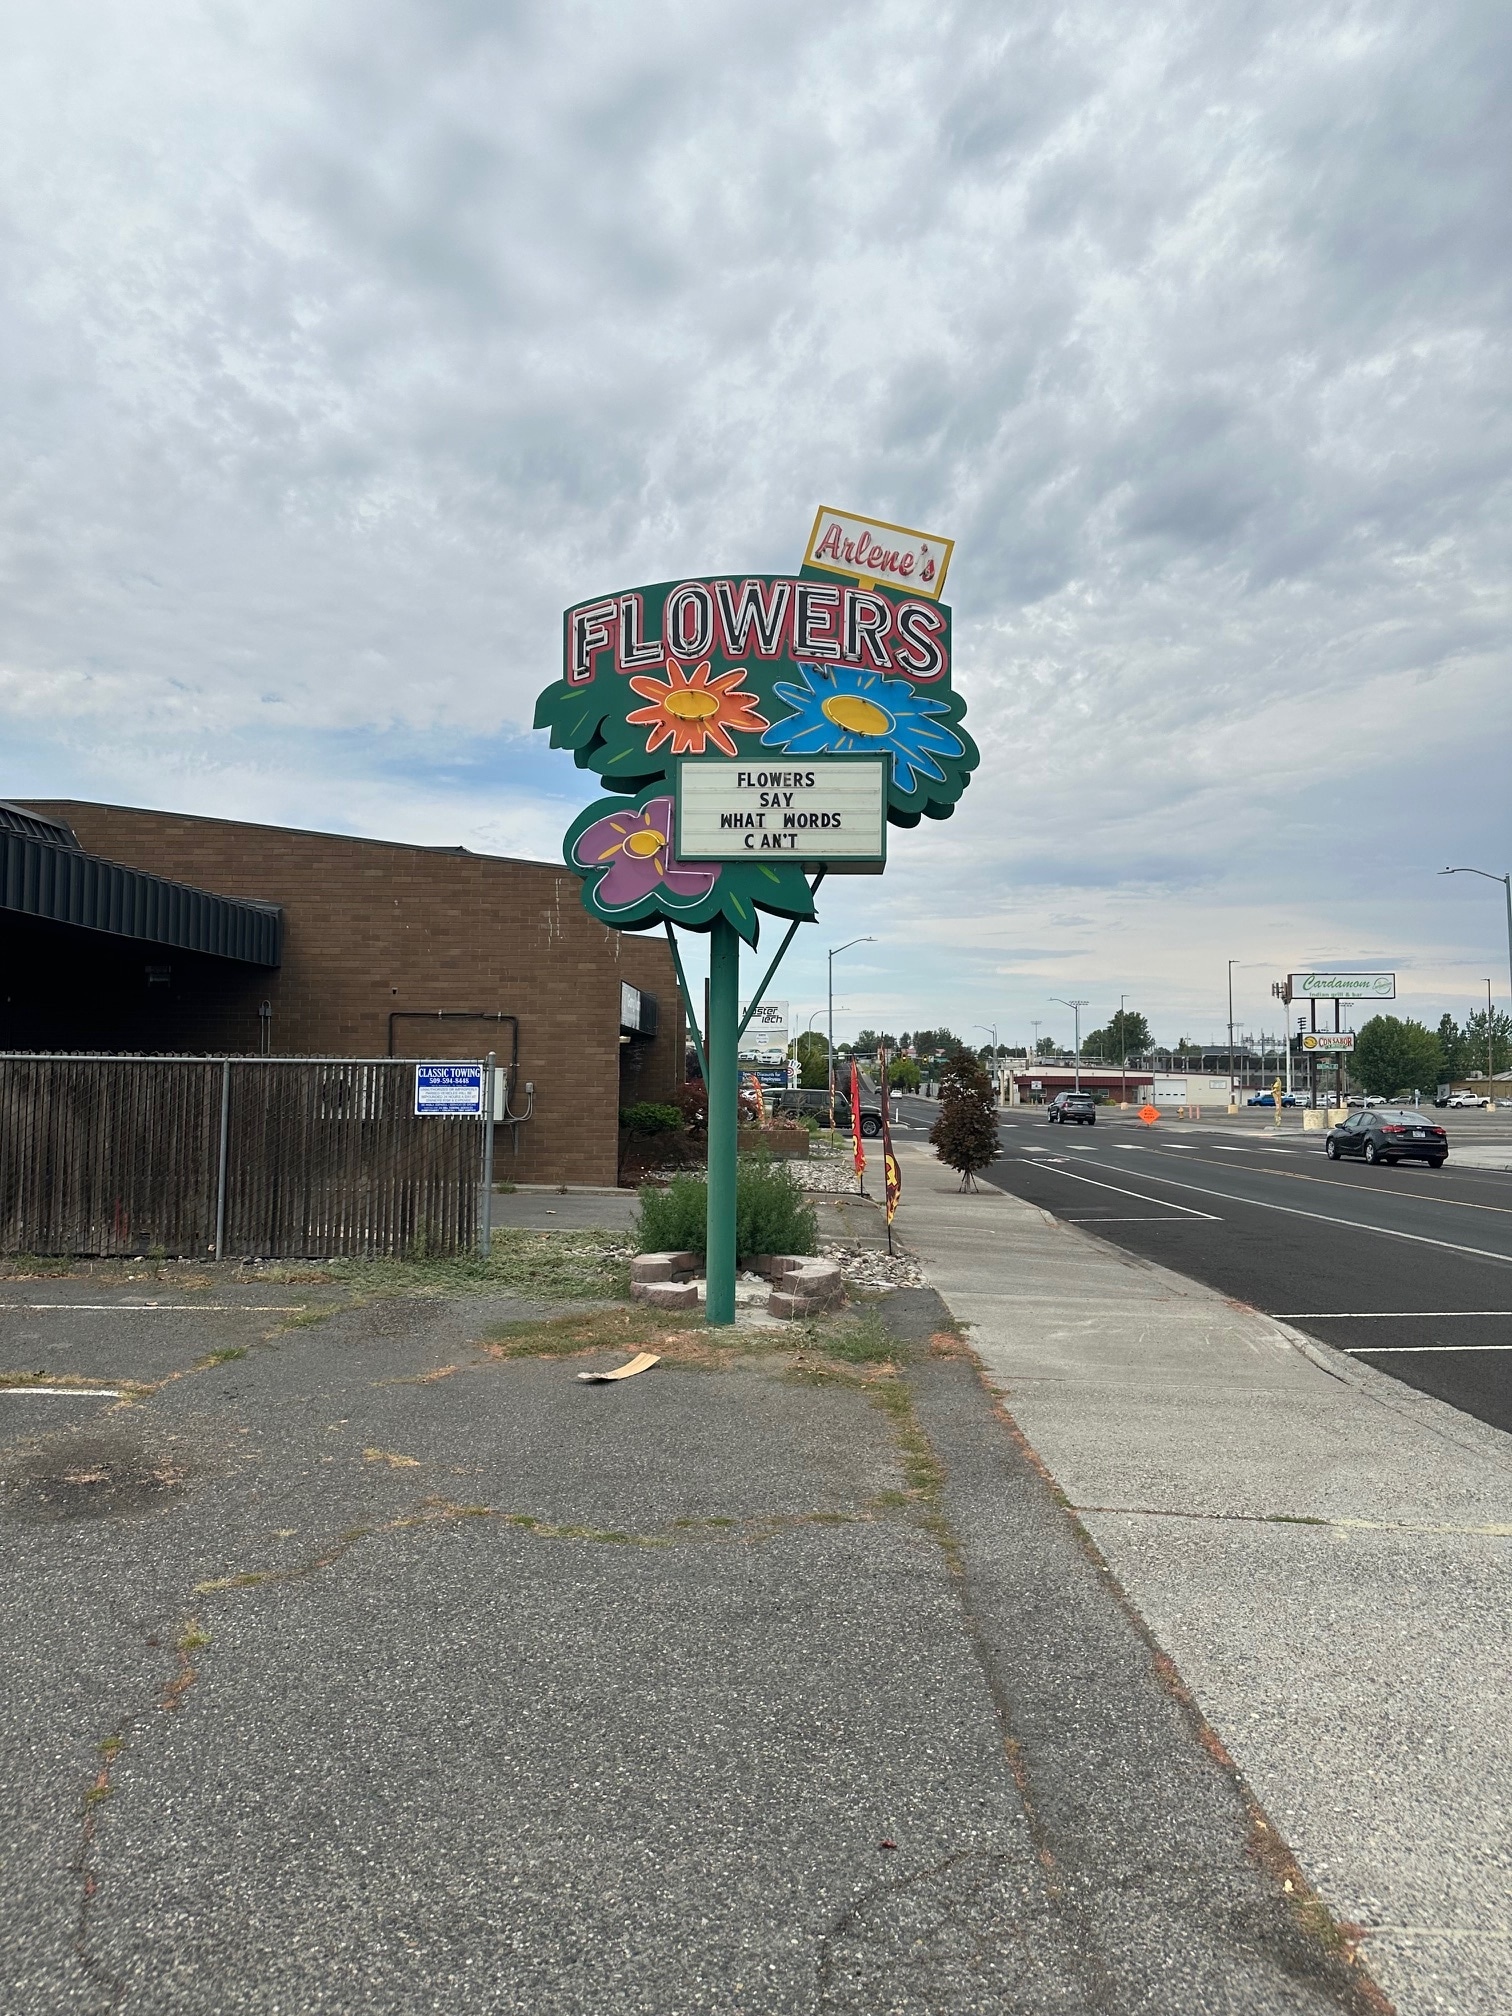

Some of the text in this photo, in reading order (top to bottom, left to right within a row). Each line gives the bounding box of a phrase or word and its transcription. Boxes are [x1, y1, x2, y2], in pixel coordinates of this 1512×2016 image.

[815, 523, 936, 582] Arlene's
[569, 580, 945, 684] FLOWERS
[737, 772, 815, 787] FLOWERS
[759, 792, 794, 807] SAY
[720, 813, 841, 828] WHAT WORDS
[1302, 975, 1370, 991] Cardamom
[418, 1068, 480, 1077] CLASSIC TOWING
